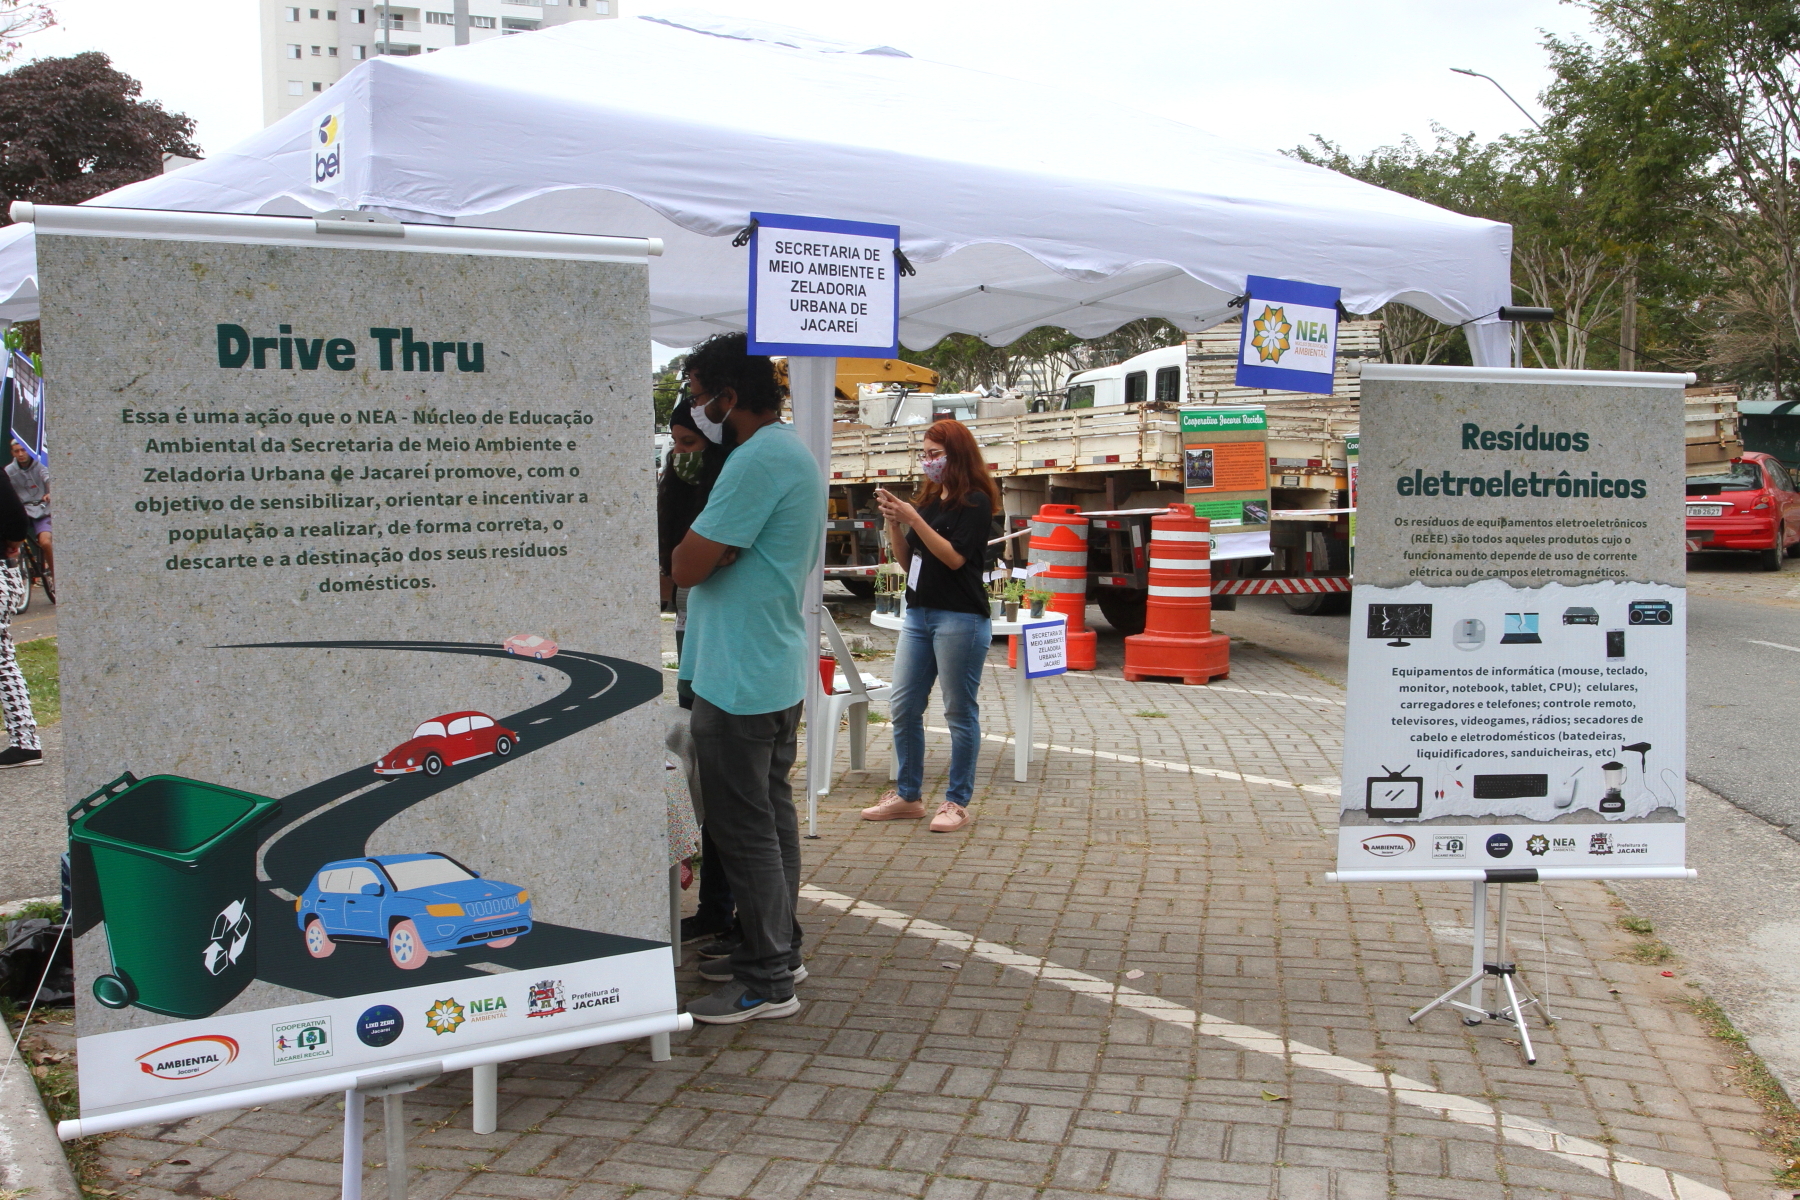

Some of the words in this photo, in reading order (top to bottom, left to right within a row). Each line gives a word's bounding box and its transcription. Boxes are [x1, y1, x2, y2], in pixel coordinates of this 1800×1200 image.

[316, 143, 340, 183] bel
[775, 241, 860, 260] SECRETARIA
[864, 248, 880, 261] DE
[769, 260, 804, 274] MEIO
[808, 262, 874, 279] AMBIENTE
[878, 268, 885, 280] E
[791, 280, 866, 296] ZELADORIA
[790, 299, 846, 314] URBANA
[850, 302, 868, 316] DE
[800, 318, 858, 333] JACAREÍ
[1296, 320, 1328, 344] NEA
[218, 323, 356, 372] Drive
[370, 326, 485, 373] Thru
[1294, 347, 1327, 358] AMBIENTAL
[122, 409, 170, 424] Essa
[176, 406, 188, 424] é
[194, 412, 239, 424] uma
[246, 408, 292, 428] ação
[298, 412, 334, 428] que
[341, 412, 352, 424] o
[358, 410, 397, 424] NEA
[414, 408, 476, 424] Núcleo
[482, 410, 503, 424] de
[509, 410, 594, 428] Educação
[146, 438, 256, 453] Ambiental
[261, 438, 285, 452] da
[291, 437, 393, 452] Secretaria
[399, 437, 421, 451] de
[427, 437, 470, 451] Meio
[475, 437, 562, 451] Ambiente
[567, 440, 576, 450] e
[1462, 422, 1590, 452] Resíduos
[144, 466, 244, 482] Zeladoria
[252, 466, 324, 481] Urbana
[331, 465, 354, 480] de
[360, 463, 430, 480] Jacareí
[434, 466, 522, 482] promove,
[528, 466, 564, 478] com
[570, 466, 580, 478] o
[1396, 468, 1646, 499] eletroeletrônicos
[134, 496, 224, 516] objetivo
[230, 495, 254, 510] de
[260, 493, 380, 510] sensibilizar,
[386, 492, 463, 507] orientar
[468, 494, 478, 506] e
[483, 490, 574, 505] incentivar
[579, 492, 588, 503] a
[1394, 518, 1408, 526] Os
[1412, 516, 1459, 526] resíduos
[1462, 518, 1474, 526] de
[1477, 518, 1552, 528] equipamentos
[1556, 518, 1647, 528] eletroeletrônicos
[168, 523, 278, 544] população
[284, 526, 294, 538] a
[300, 521, 382, 538] realizar,
[388, 520, 410, 534] de
[416, 519, 472, 533] forma
[477, 518, 548, 533] correta,
[553, 519, 563, 530] o
[1411, 534, 1448, 544] (REEE)
[1451, 534, 1470, 544] são
[1472, 534, 1502, 544] todos
[1506, 535, 1546, 546] aqueles
[1548, 535, 1598, 546] produtos
[1602, 535, 1622, 546] cujo
[166, 554, 257, 570] descarte
[263, 555, 274, 567] e
[280, 554, 290, 566] a
[296, 547, 404, 567] destinação
[409, 547, 442, 562] dos
[447, 548, 486, 560] seus
[492, 542, 568, 558] resíduos
[1404, 550, 1488, 560] funcionamento
[1490, 551, 1536, 562] depende
[1538, 551, 1552, 560] de
[1576, 552, 1590, 560] de
[1594, 552, 1638, 560] corrente
[1409, 566, 1452, 576] elétrica
[1472, 568, 1484, 576] de
[1487, 569, 1528, 578] campos
[1530, 566, 1628, 579] eletromagnéticos.
[319, 574, 436, 592] domésticos.
[1392, 667, 1473, 678] Equipamentos
[1476, 667, 1488, 676] de
[1492, 665, 1554, 676] informática
[1558, 666, 1604, 677] (mouse,
[1606, 666, 1648, 676] teclado,
[1399, 683, 1450, 694] monitor,
[1452, 683, 1508, 694] notebook,
[1511, 683, 1546, 694] tablet,
[1550, 682, 1581, 694] CPU);
[1586, 682, 1638, 692] celulares,
[1400, 700, 1474, 711] carregadores
[1486, 699, 1540, 709] telefones;
[1543, 699, 1590, 708] controle
[1594, 700, 1636, 709] remoto,
[1392, 716, 1458, 728] televisores,
[1462, 716, 1530, 727] videogames,
[1532, 714, 1570, 726] rádios;
[1574, 715, 1628, 724] secadores
[1631, 715, 1644, 724] de
[1410, 733, 1448, 742] cabelo
[1451, 734, 1458, 742] e
[1460, 730, 1556, 742] eletrodomésticos
[1558, 732, 1626, 742] (batedeiras,
[1416, 748, 1508, 760] liquidificadores,
[1511, 748, 1592, 758] sanduicheiras,
[1595, 748, 1616, 758] etc)
[1553, 838, 1576, 846] NEA
[572, 989, 608, 1000] Prefeitura
[610, 986, 620, 994] de
[470, 996, 507, 1014] NEA
[572, 994, 620, 1010] JACAREÍ
[471, 1012, 508, 1023] AMBIENTAL
[276, 1020, 326, 1032] COOPERATIVA
[156, 1054, 219, 1071] AMBIENTAL
[276, 1054, 302, 1062] JACAREÍ
[304, 1050, 330, 1058] RECICLA
